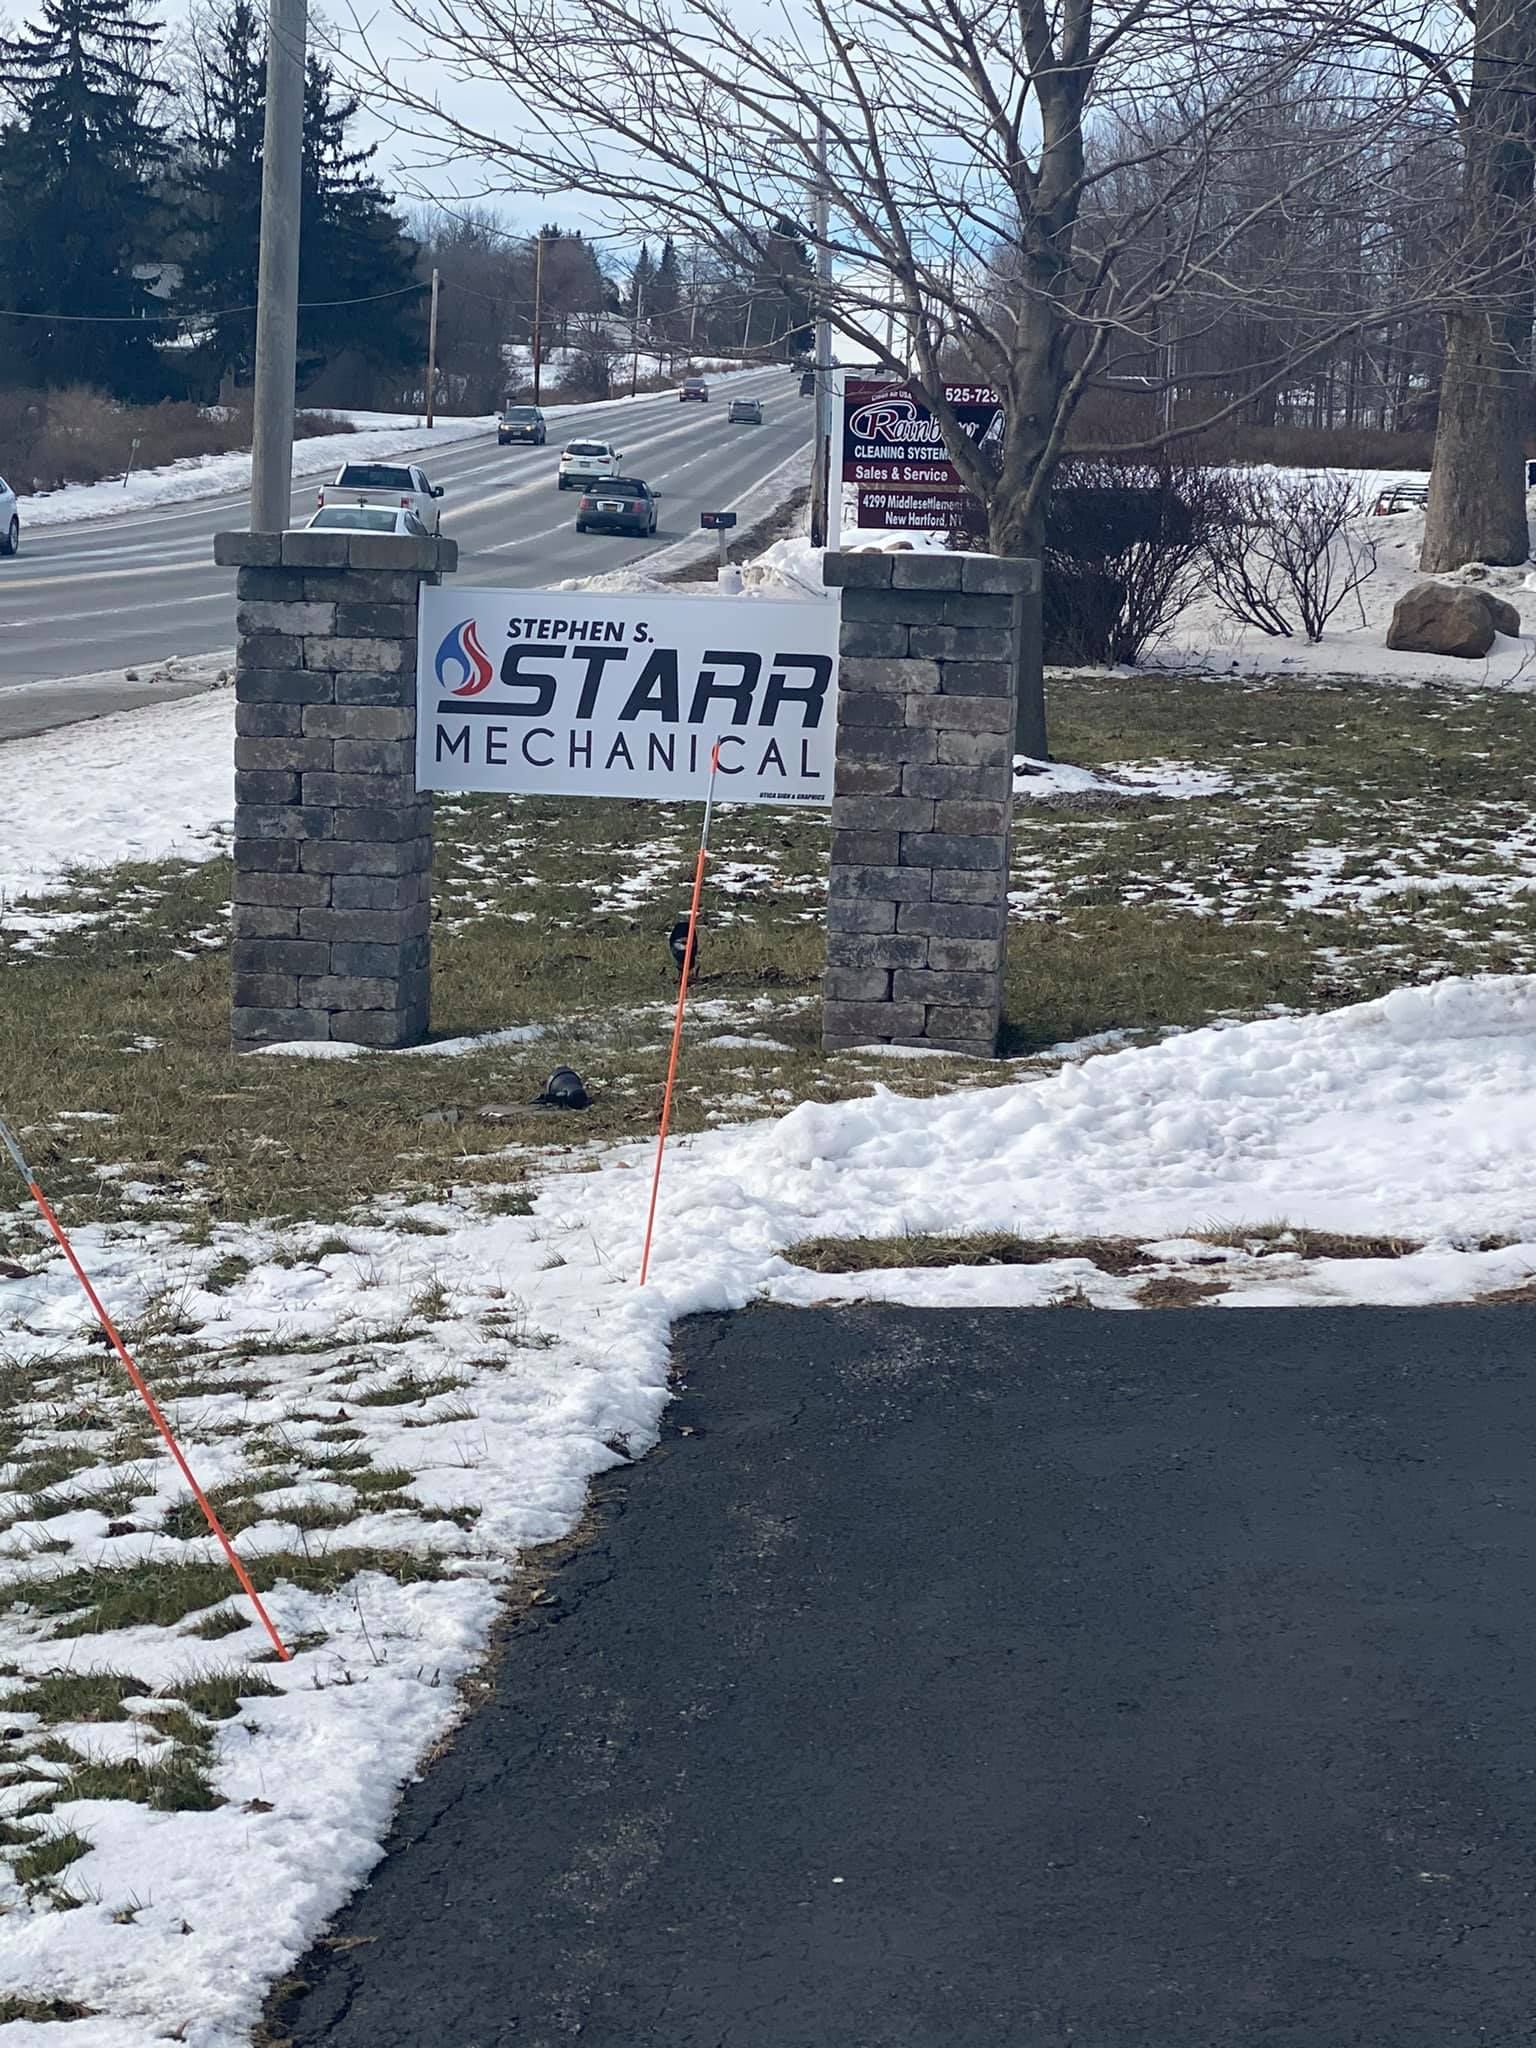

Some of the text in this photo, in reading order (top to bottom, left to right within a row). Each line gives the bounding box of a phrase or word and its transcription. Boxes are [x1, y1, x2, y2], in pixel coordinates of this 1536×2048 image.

[945, 388, 1003, 403] 525-723
[854, 445, 905, 460] CLEANING
[855, 465, 949, 482] Sales & Service
[863, 494, 887, 508] 4299
[885, 511, 907, 525] New
[506, 617, 654, 643] STEPHEN S.
[437, 644, 833, 728] STARR
[436, 724, 820, 778] MECHANICAL
